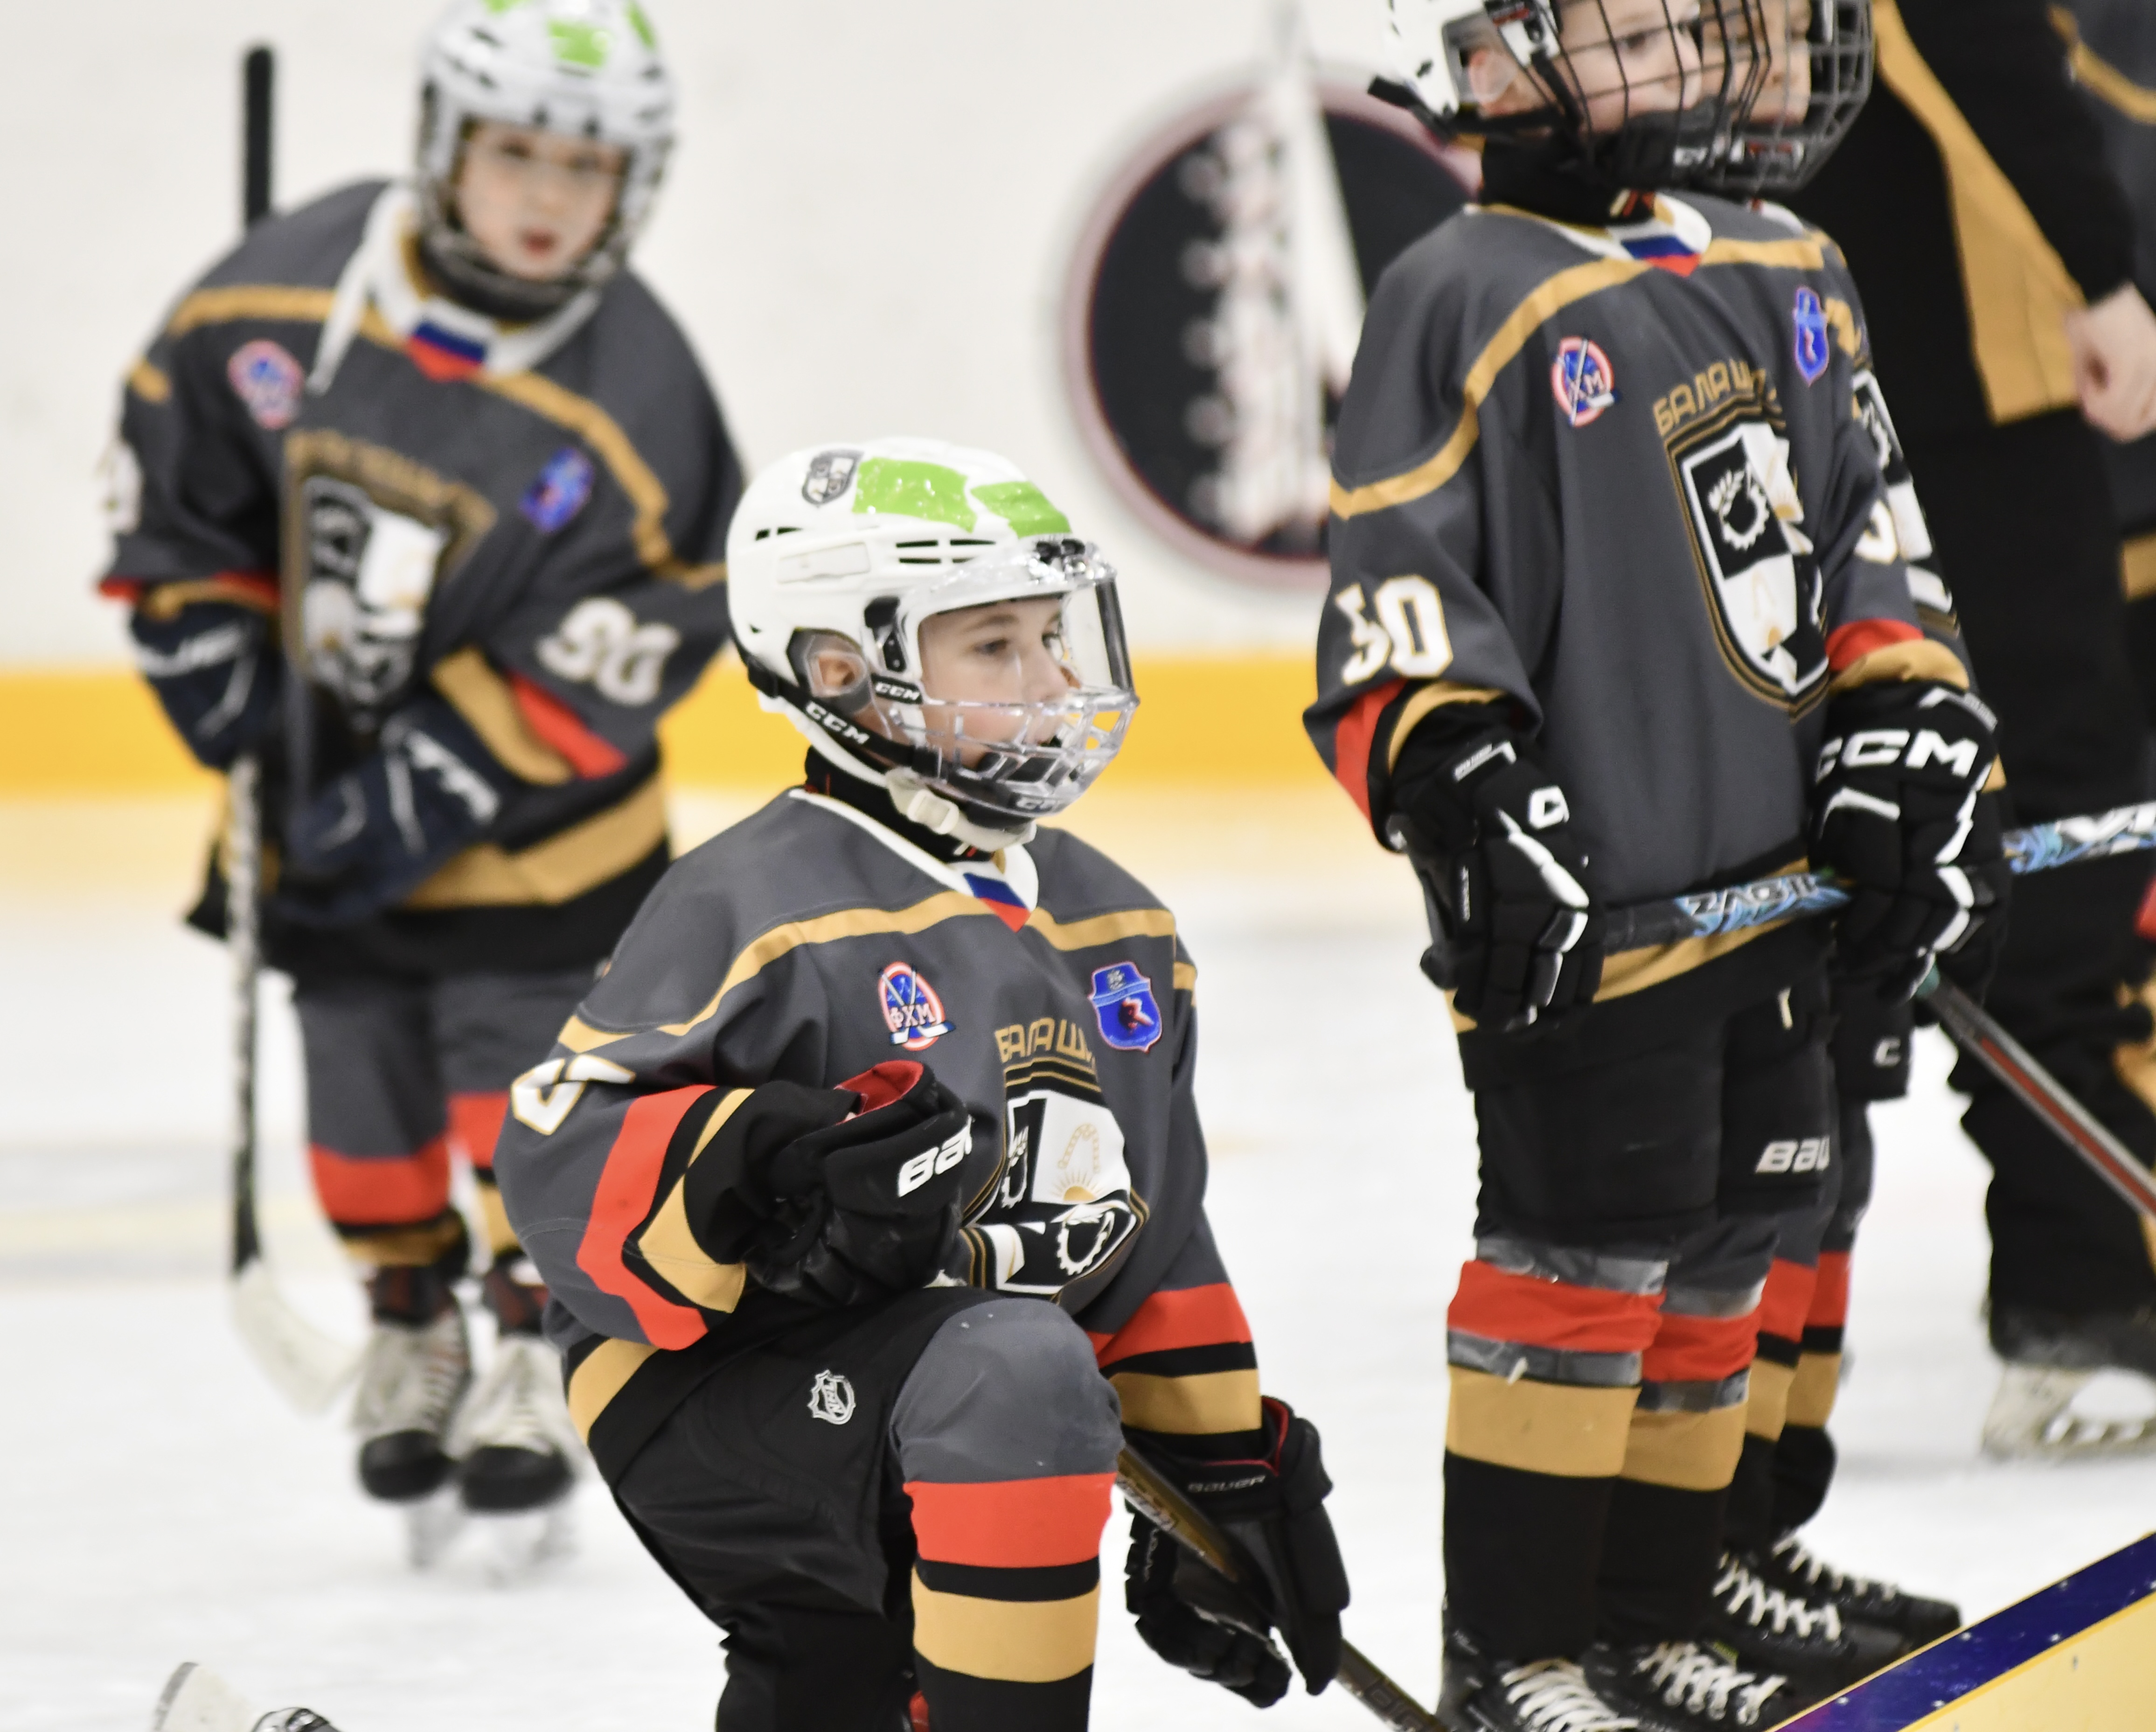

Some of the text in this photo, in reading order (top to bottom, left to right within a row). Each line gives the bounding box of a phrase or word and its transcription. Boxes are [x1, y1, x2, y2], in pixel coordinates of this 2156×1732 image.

[1653, 358, 1766, 437] БАЛАШ
[875, 682, 920, 700] CCM
[806, 700, 871, 745] CCM
[890, 1003, 937, 1028] ФХМ
